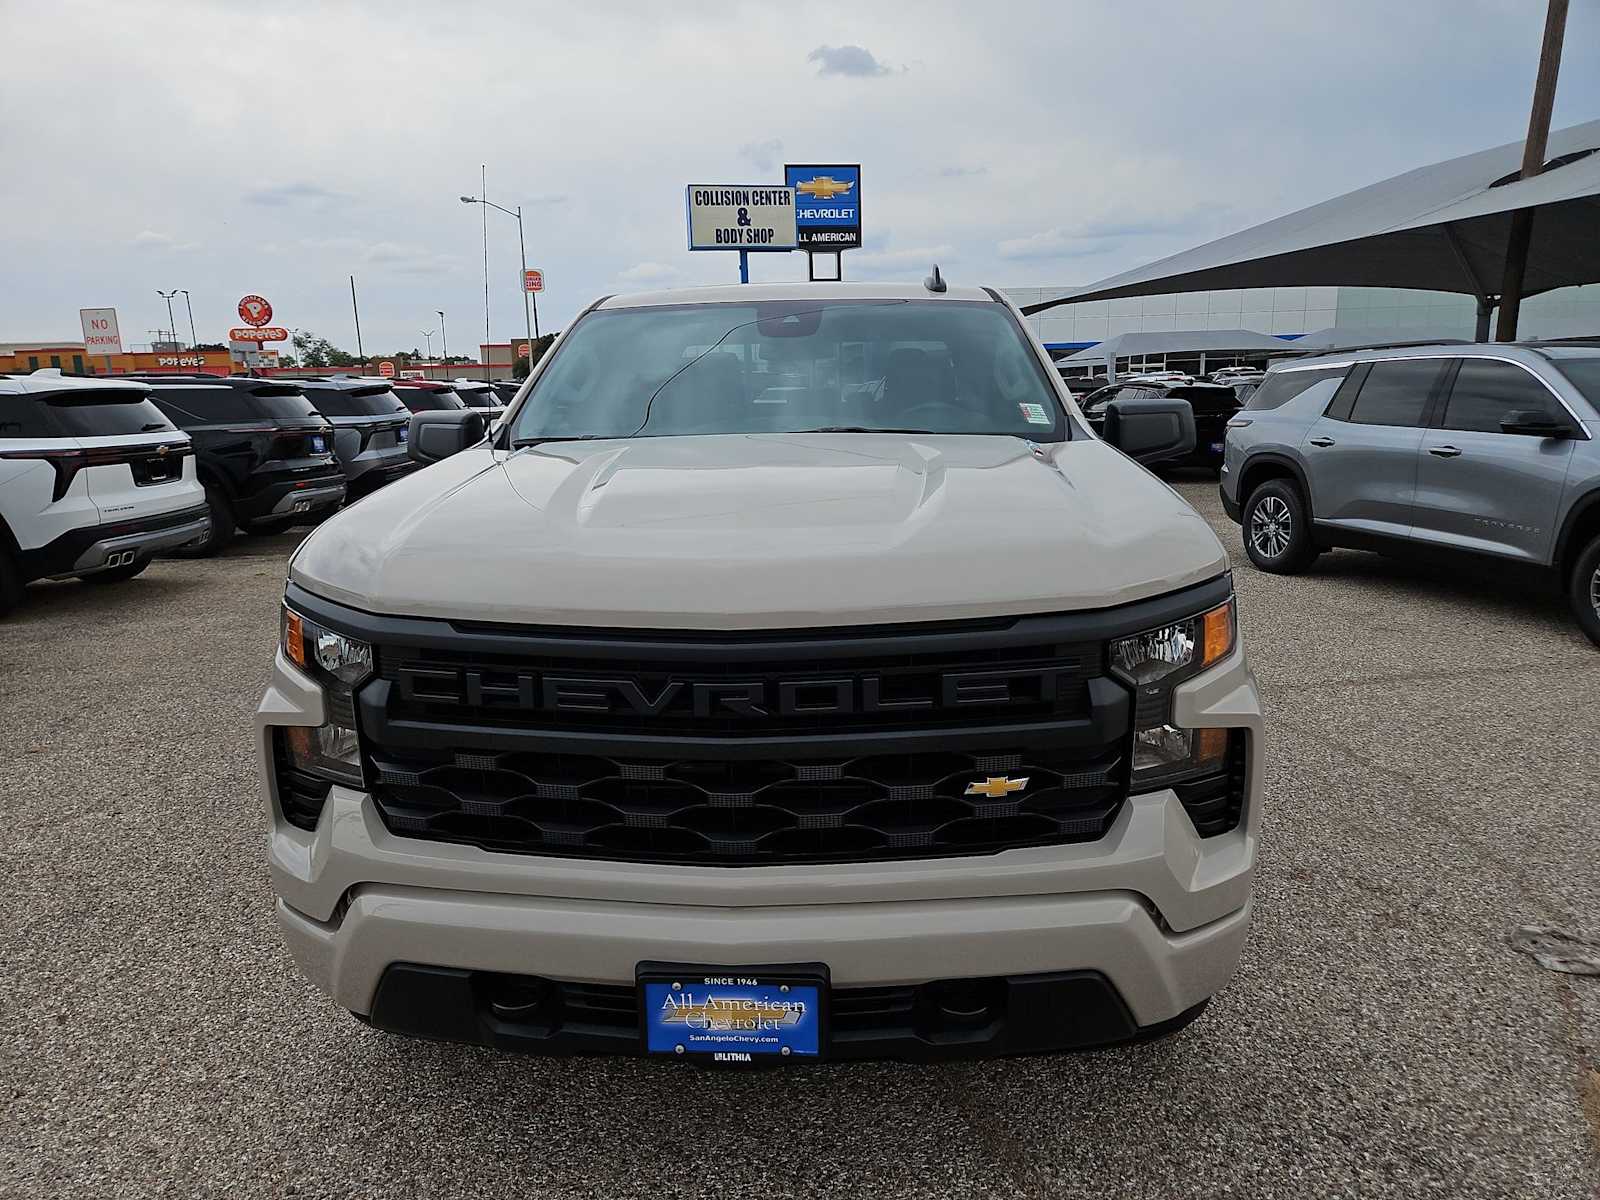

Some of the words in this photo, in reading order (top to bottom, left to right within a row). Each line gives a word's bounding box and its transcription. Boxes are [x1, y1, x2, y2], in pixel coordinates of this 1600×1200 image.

[695, 190, 749, 206] COLLISION
[752, 190, 791, 206] CENTER
[737, 207, 751, 227] &
[715, 228, 743, 244] BODY
[747, 228, 775, 244] SHOP
[797, 233, 809, 242] LL
[811, 233, 856, 242] AMERICAN
[91, 319, 108, 330] NO
[86, 335, 118, 345] PARKING
[397, 663, 1083, 718] CHEVROLET
[704, 977, 734, 986] SINCE
[736, 977, 758, 986] 1946
[661, 993, 694, 1010] All
[701, 993, 806, 1013] American
[685, 1011, 781, 1031] Chevrolet
[689, 1034, 779, 1044] SanAngeloChevy.com
[722, 1052, 752, 1062] LITHIA
